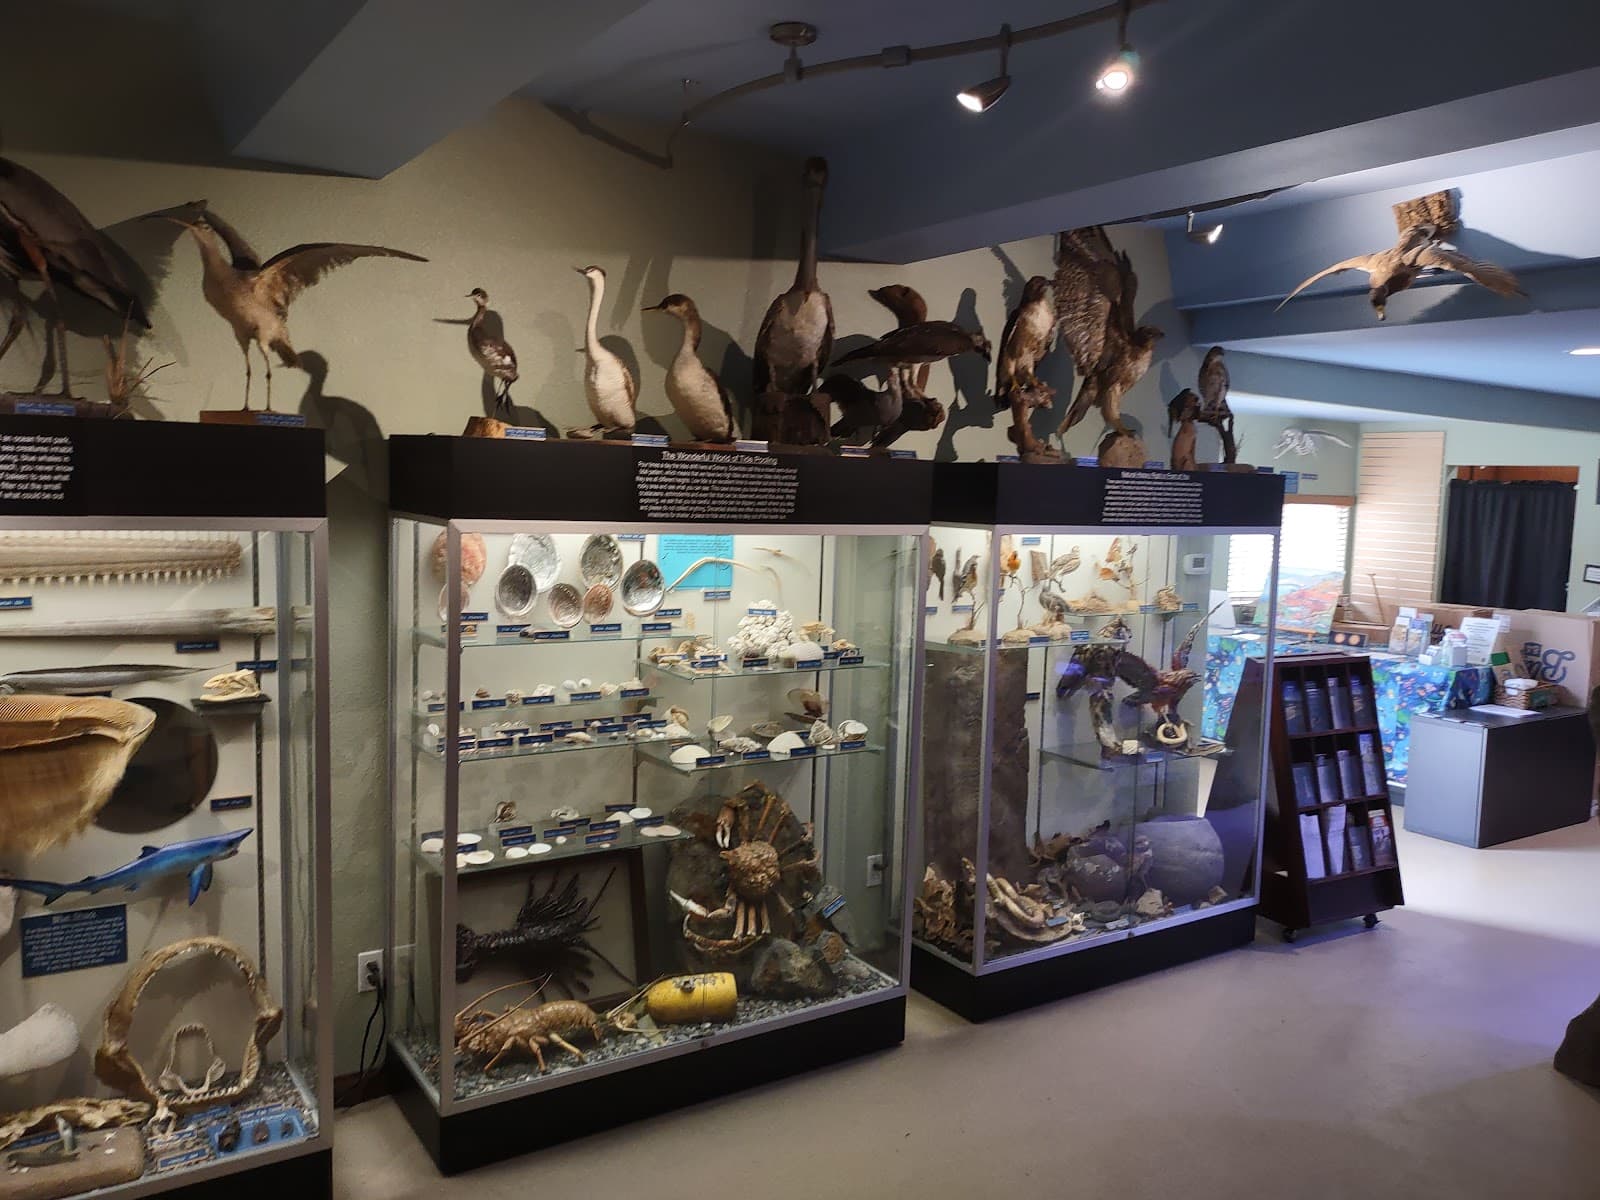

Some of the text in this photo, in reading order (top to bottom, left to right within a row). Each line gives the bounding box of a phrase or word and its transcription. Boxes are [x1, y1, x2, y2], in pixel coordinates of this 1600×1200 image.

[661, 451, 676, 460] The
[676, 452, 711, 461] Wonderful
[712, 454, 730, 462] World
